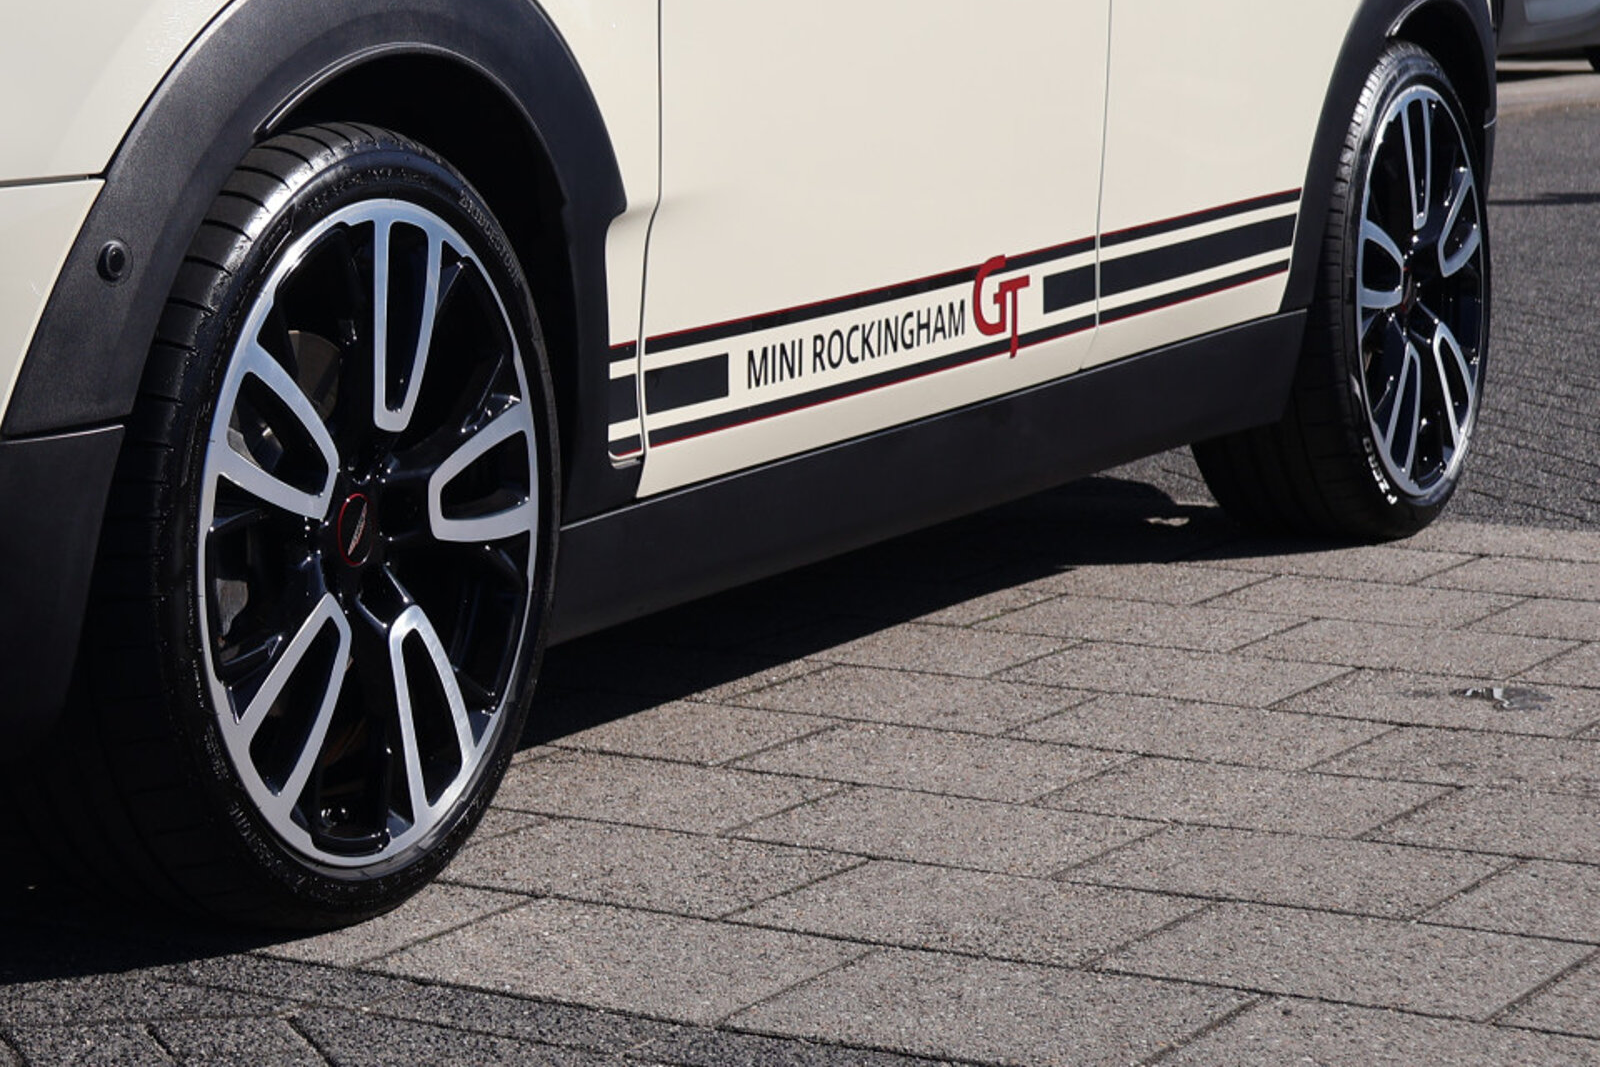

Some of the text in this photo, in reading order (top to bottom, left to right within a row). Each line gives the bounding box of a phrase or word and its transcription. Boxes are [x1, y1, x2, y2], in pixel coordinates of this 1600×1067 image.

[747, 255, 1030, 390] MINI ROCKINGHAM GT
